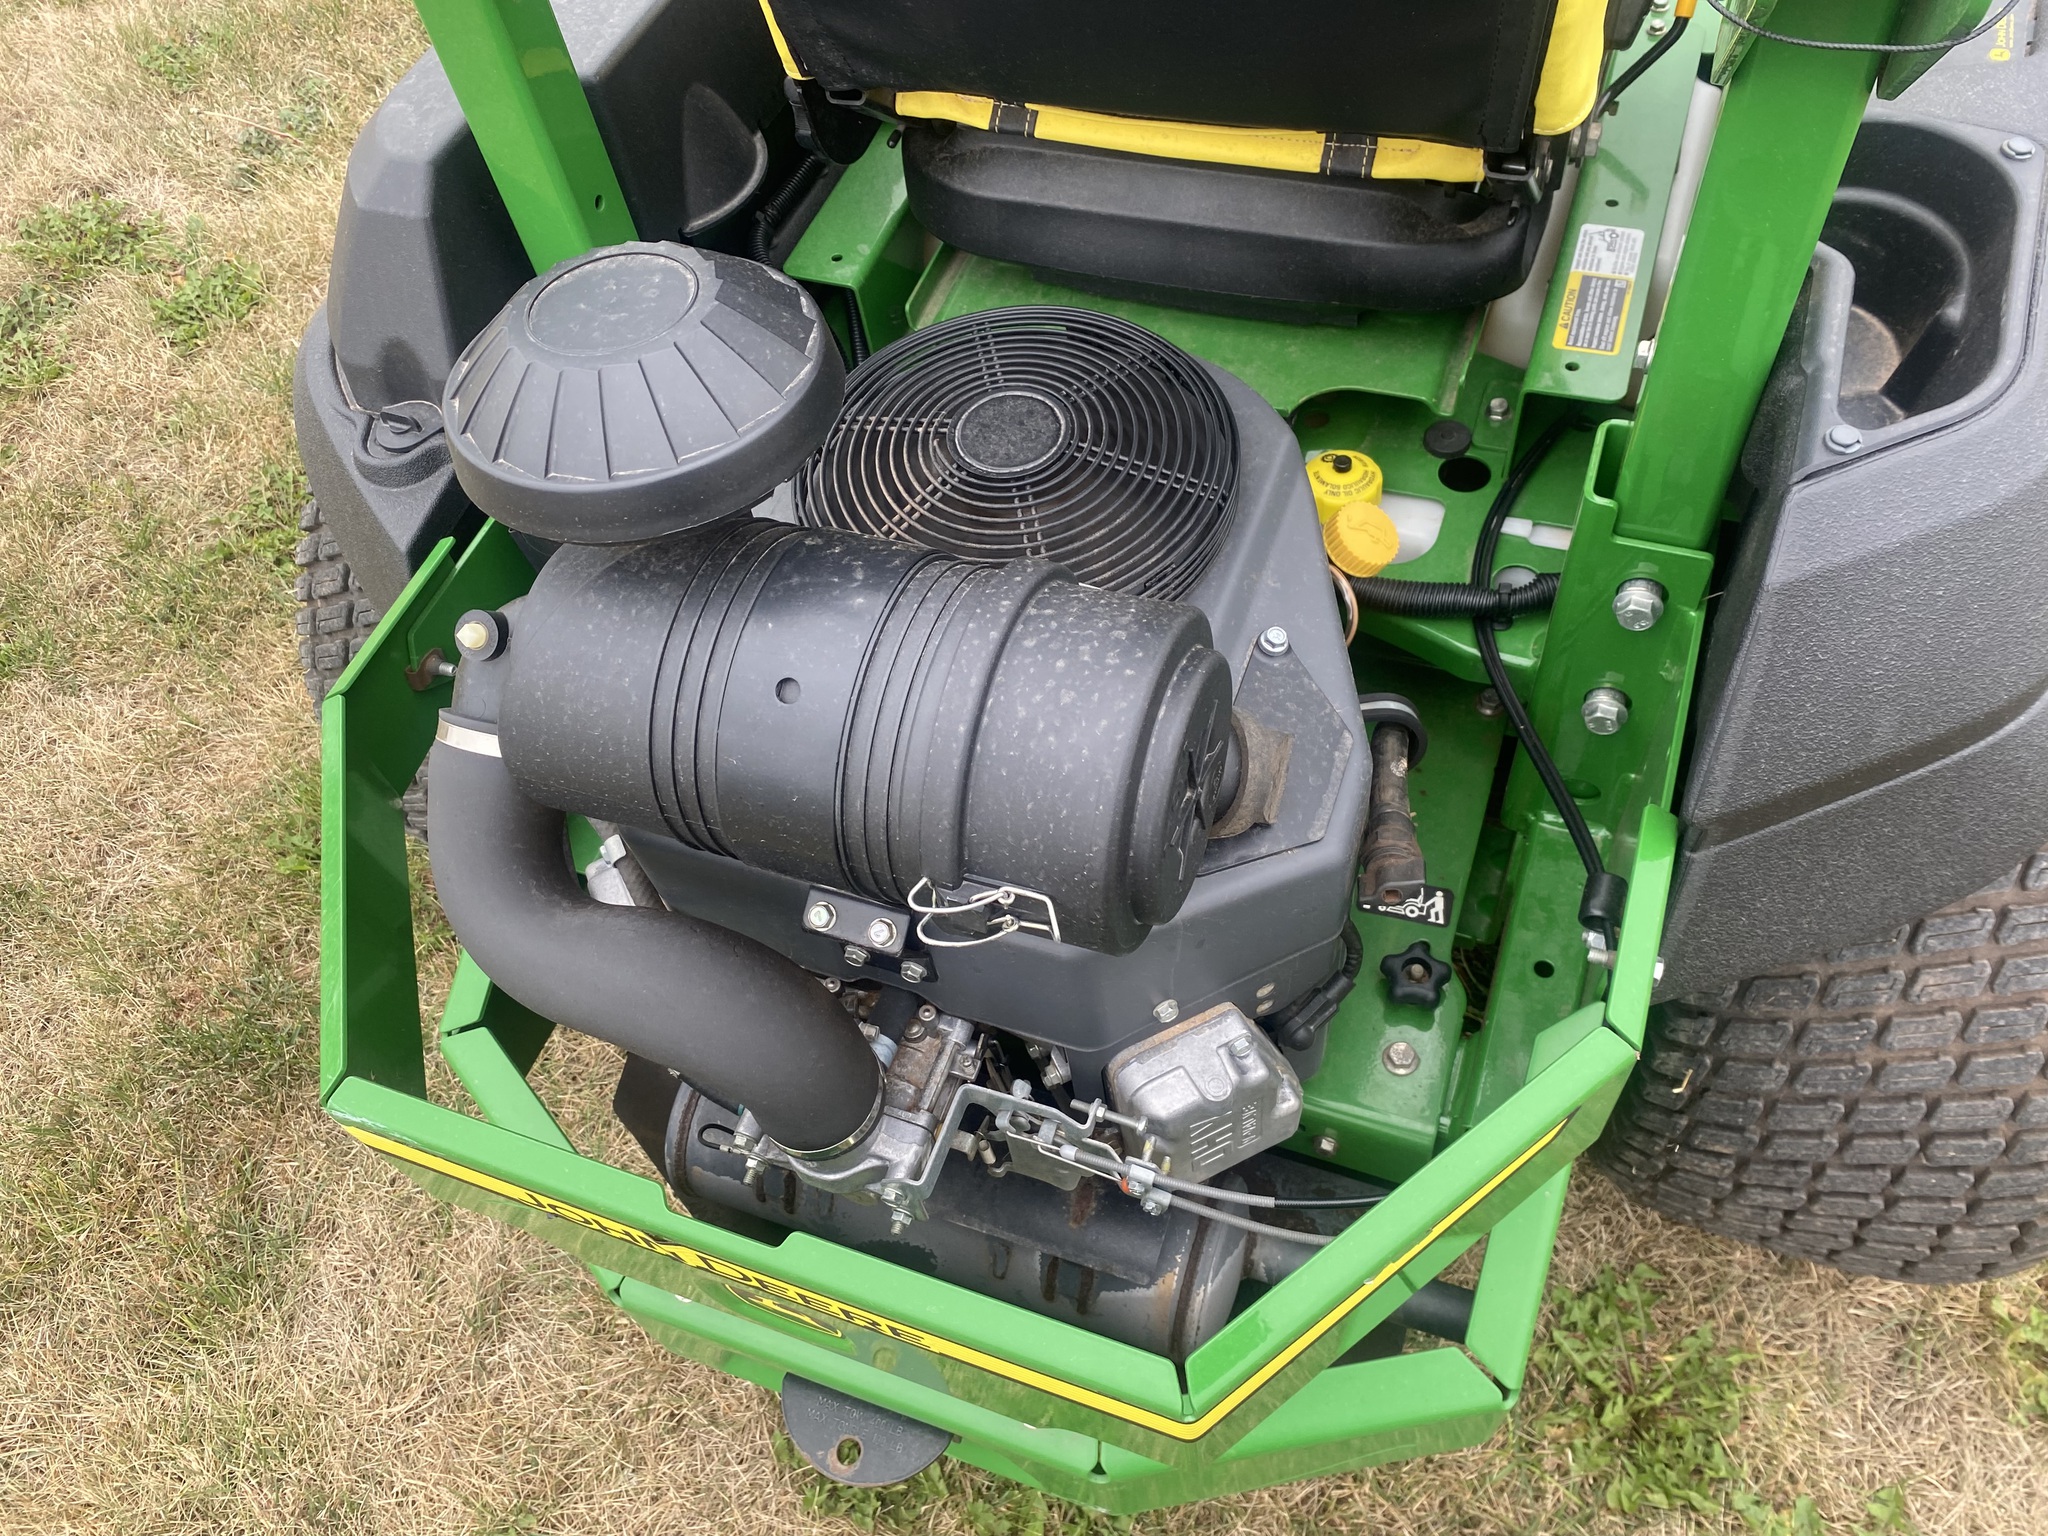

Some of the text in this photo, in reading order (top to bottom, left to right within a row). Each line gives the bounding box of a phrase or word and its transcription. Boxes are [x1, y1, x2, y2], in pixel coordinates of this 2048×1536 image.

[1560, 288, 1577, 323] CAUTION
[1324, 489, 1341, 497] ONLY
[1354, 470, 1376, 494] HYDRAULIC
[518, 1191, 932, 1349] JOHN DEERE
[806, 1408, 828, 1423] MAX
[889, 1440, 904, 1453] LB
[815, 1396, 839, 1412] MAX
[889, 1423, 904, 1437] LB
